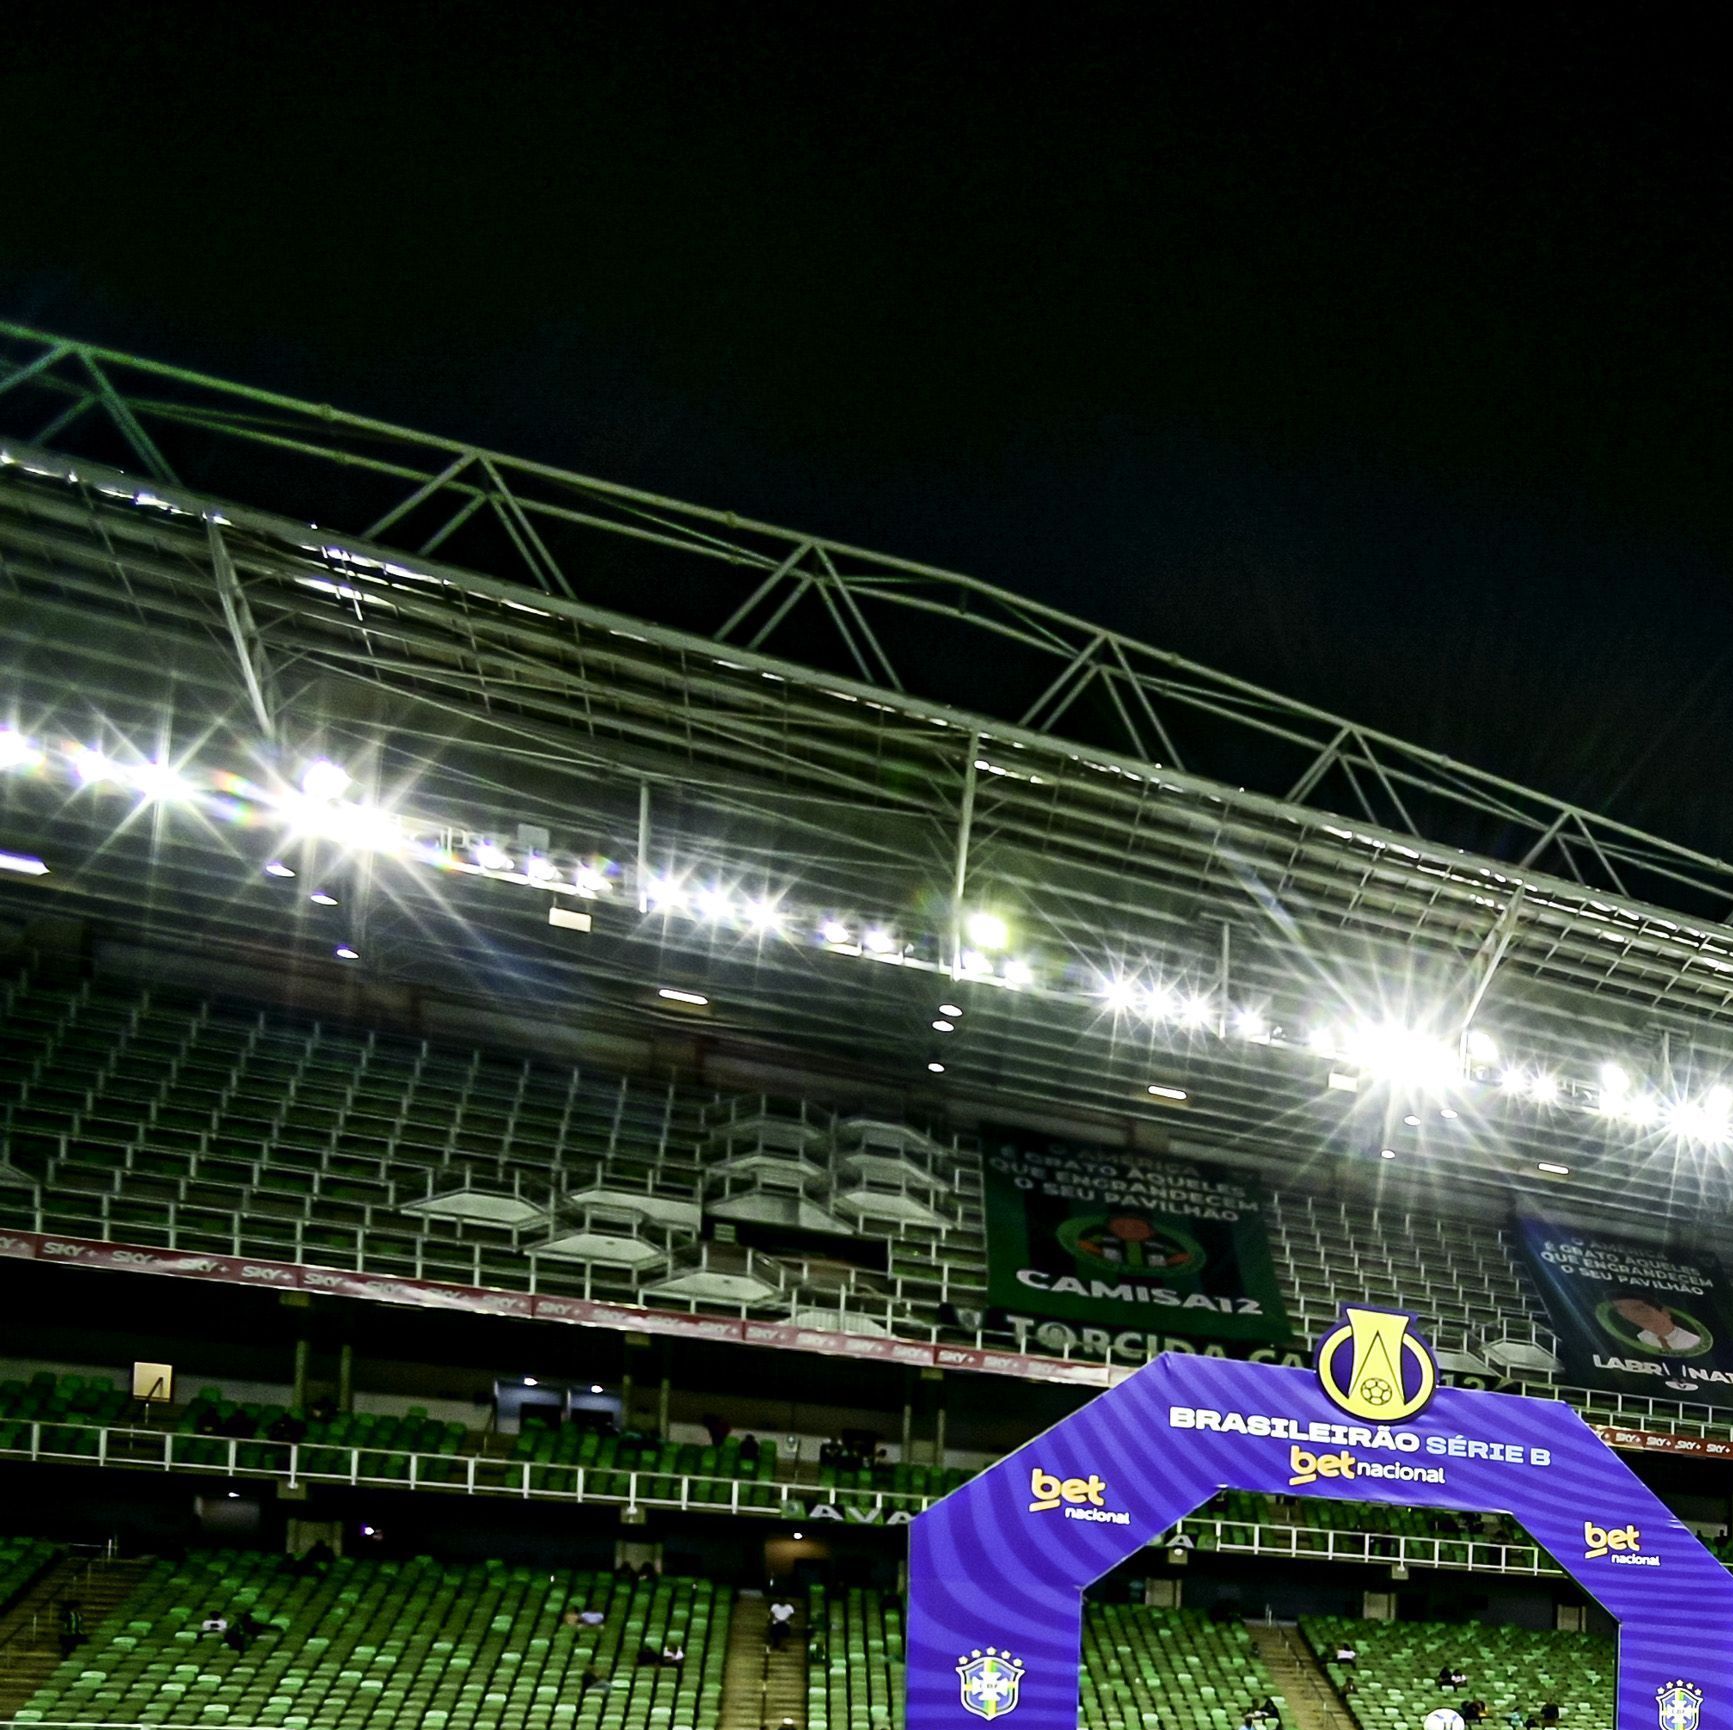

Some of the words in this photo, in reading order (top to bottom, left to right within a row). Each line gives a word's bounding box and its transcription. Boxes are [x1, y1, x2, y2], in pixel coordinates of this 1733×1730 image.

[1042, 1181, 1096, 1202] SEU
[241, 1265, 293, 1281] SKY+
[1578, 1267, 1613, 1281] SEU
[1016, 1269, 1264, 1316] CAMISA12
[1169, 1406, 1421, 1452] BRASILEIRÃO
[1425, 1434, 1524, 1465] SÉRIE
[1530, 1448, 1552, 1467] B
[1615, 1432, 1641, 1443] SKY+
[1646, 1436, 1671, 1447] SKY+
[1675, 1440, 1701, 1450] SKY+
[1706, 1443, 1731, 1454] SKY+
[1030, 1468, 1107, 1508] bet
[1064, 1507, 1130, 1525] nacional
[1584, 1520, 1640, 1554] bet
[1611, 1553, 1661, 1567] nacional
